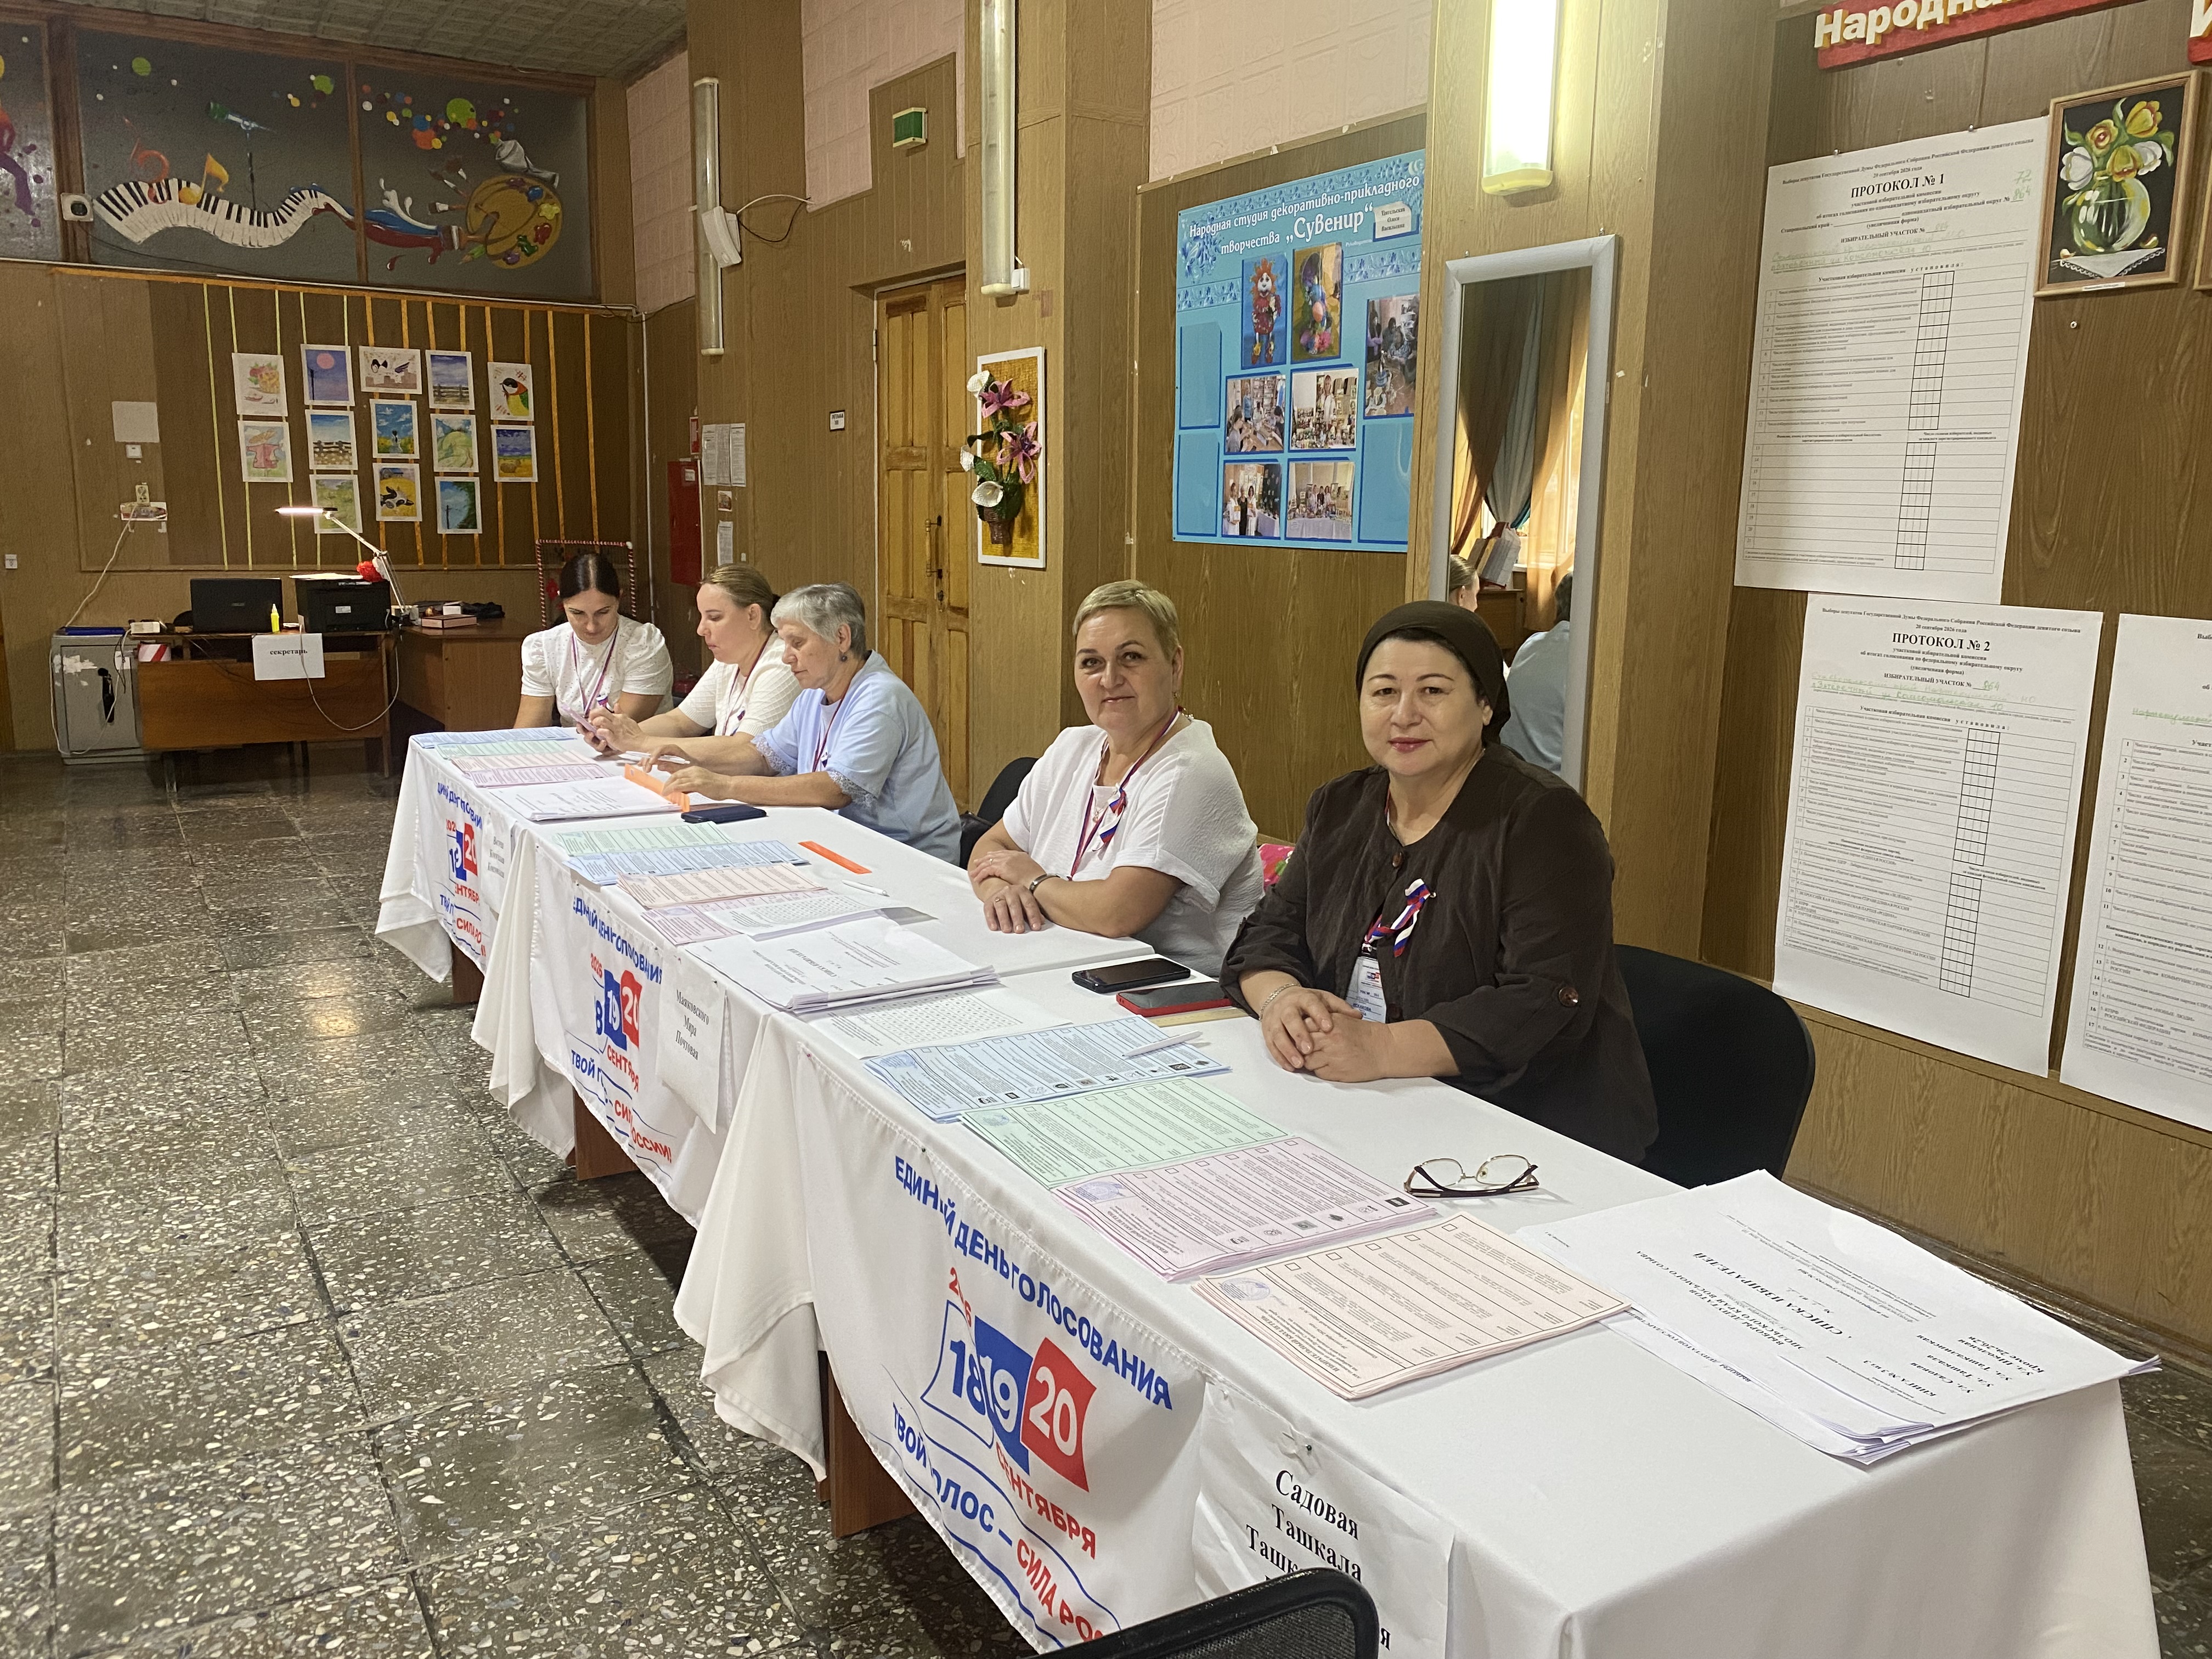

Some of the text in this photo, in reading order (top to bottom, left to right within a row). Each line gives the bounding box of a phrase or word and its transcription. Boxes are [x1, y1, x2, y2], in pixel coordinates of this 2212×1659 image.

[1850, 173, 1944, 198] ПРОТОКОЛ № 1
[1189, 174, 1420, 238] Народная студия декоративно-прикладного
[1221, 232, 1280, 255] творчества
[1841, 231, 1889, 243] ИЗБИРАТЕЛЬНЫЙ
[1892, 633, 1990, 651] ПРОТОКОЛ № 2
[1884, 673, 1934, 684] ИЗБИРАТЕЛЬНЫЙ
[607, 990, 620, 1031] 19
[676, 989, 710, 1025] Маяковского
[683, 1014, 697, 1037] Мира
[675, 1030, 699, 1060] Почтовая
[571, 1049, 595, 1079] ТВОЙ
[631, 1127, 672, 1163] ОССИИ!
[1637, 1250, 1669, 1271] СОЗЫВА
[1669, 1271, 1717, 1298] ВОСЬМОГО
[1692, 1252, 1843, 1335] СПИСКА ИЗБИРАТЕЛЕЙ
[954, 1219, 1012, 1280] ДЕНЬ
[1011, 1263, 1173, 1411] ГОЛОСОВАНИЯ
[1689, 1289, 1785, 1345] ВЫБОРЫ ДЕПУТАТОВ
[1717, 1298, 1742, 1314] КРАЯ
[1916, 1334, 2012, 1381] Ул. Ташкалинская
[1927, 1355, 1994, 1387] Ул. Ташкала
[1957, 1339, 2034, 1376] Ул. Школьная
[2009, 1354, 2045, 1373] Кроме
[1900, 1378, 1937, 1397] КНИГА
[1910, 1362, 1974, 1393] Ул. Садовая
[1028, 1365, 1078, 1457] 20
[893, 1402, 927, 1468] ТВОЙ
[1016, 1538, 1058, 1617] СИЛА
[1276, 1469, 1359, 1540] Садовая
[1272, 1503, 1362, 1583] Ташкала
